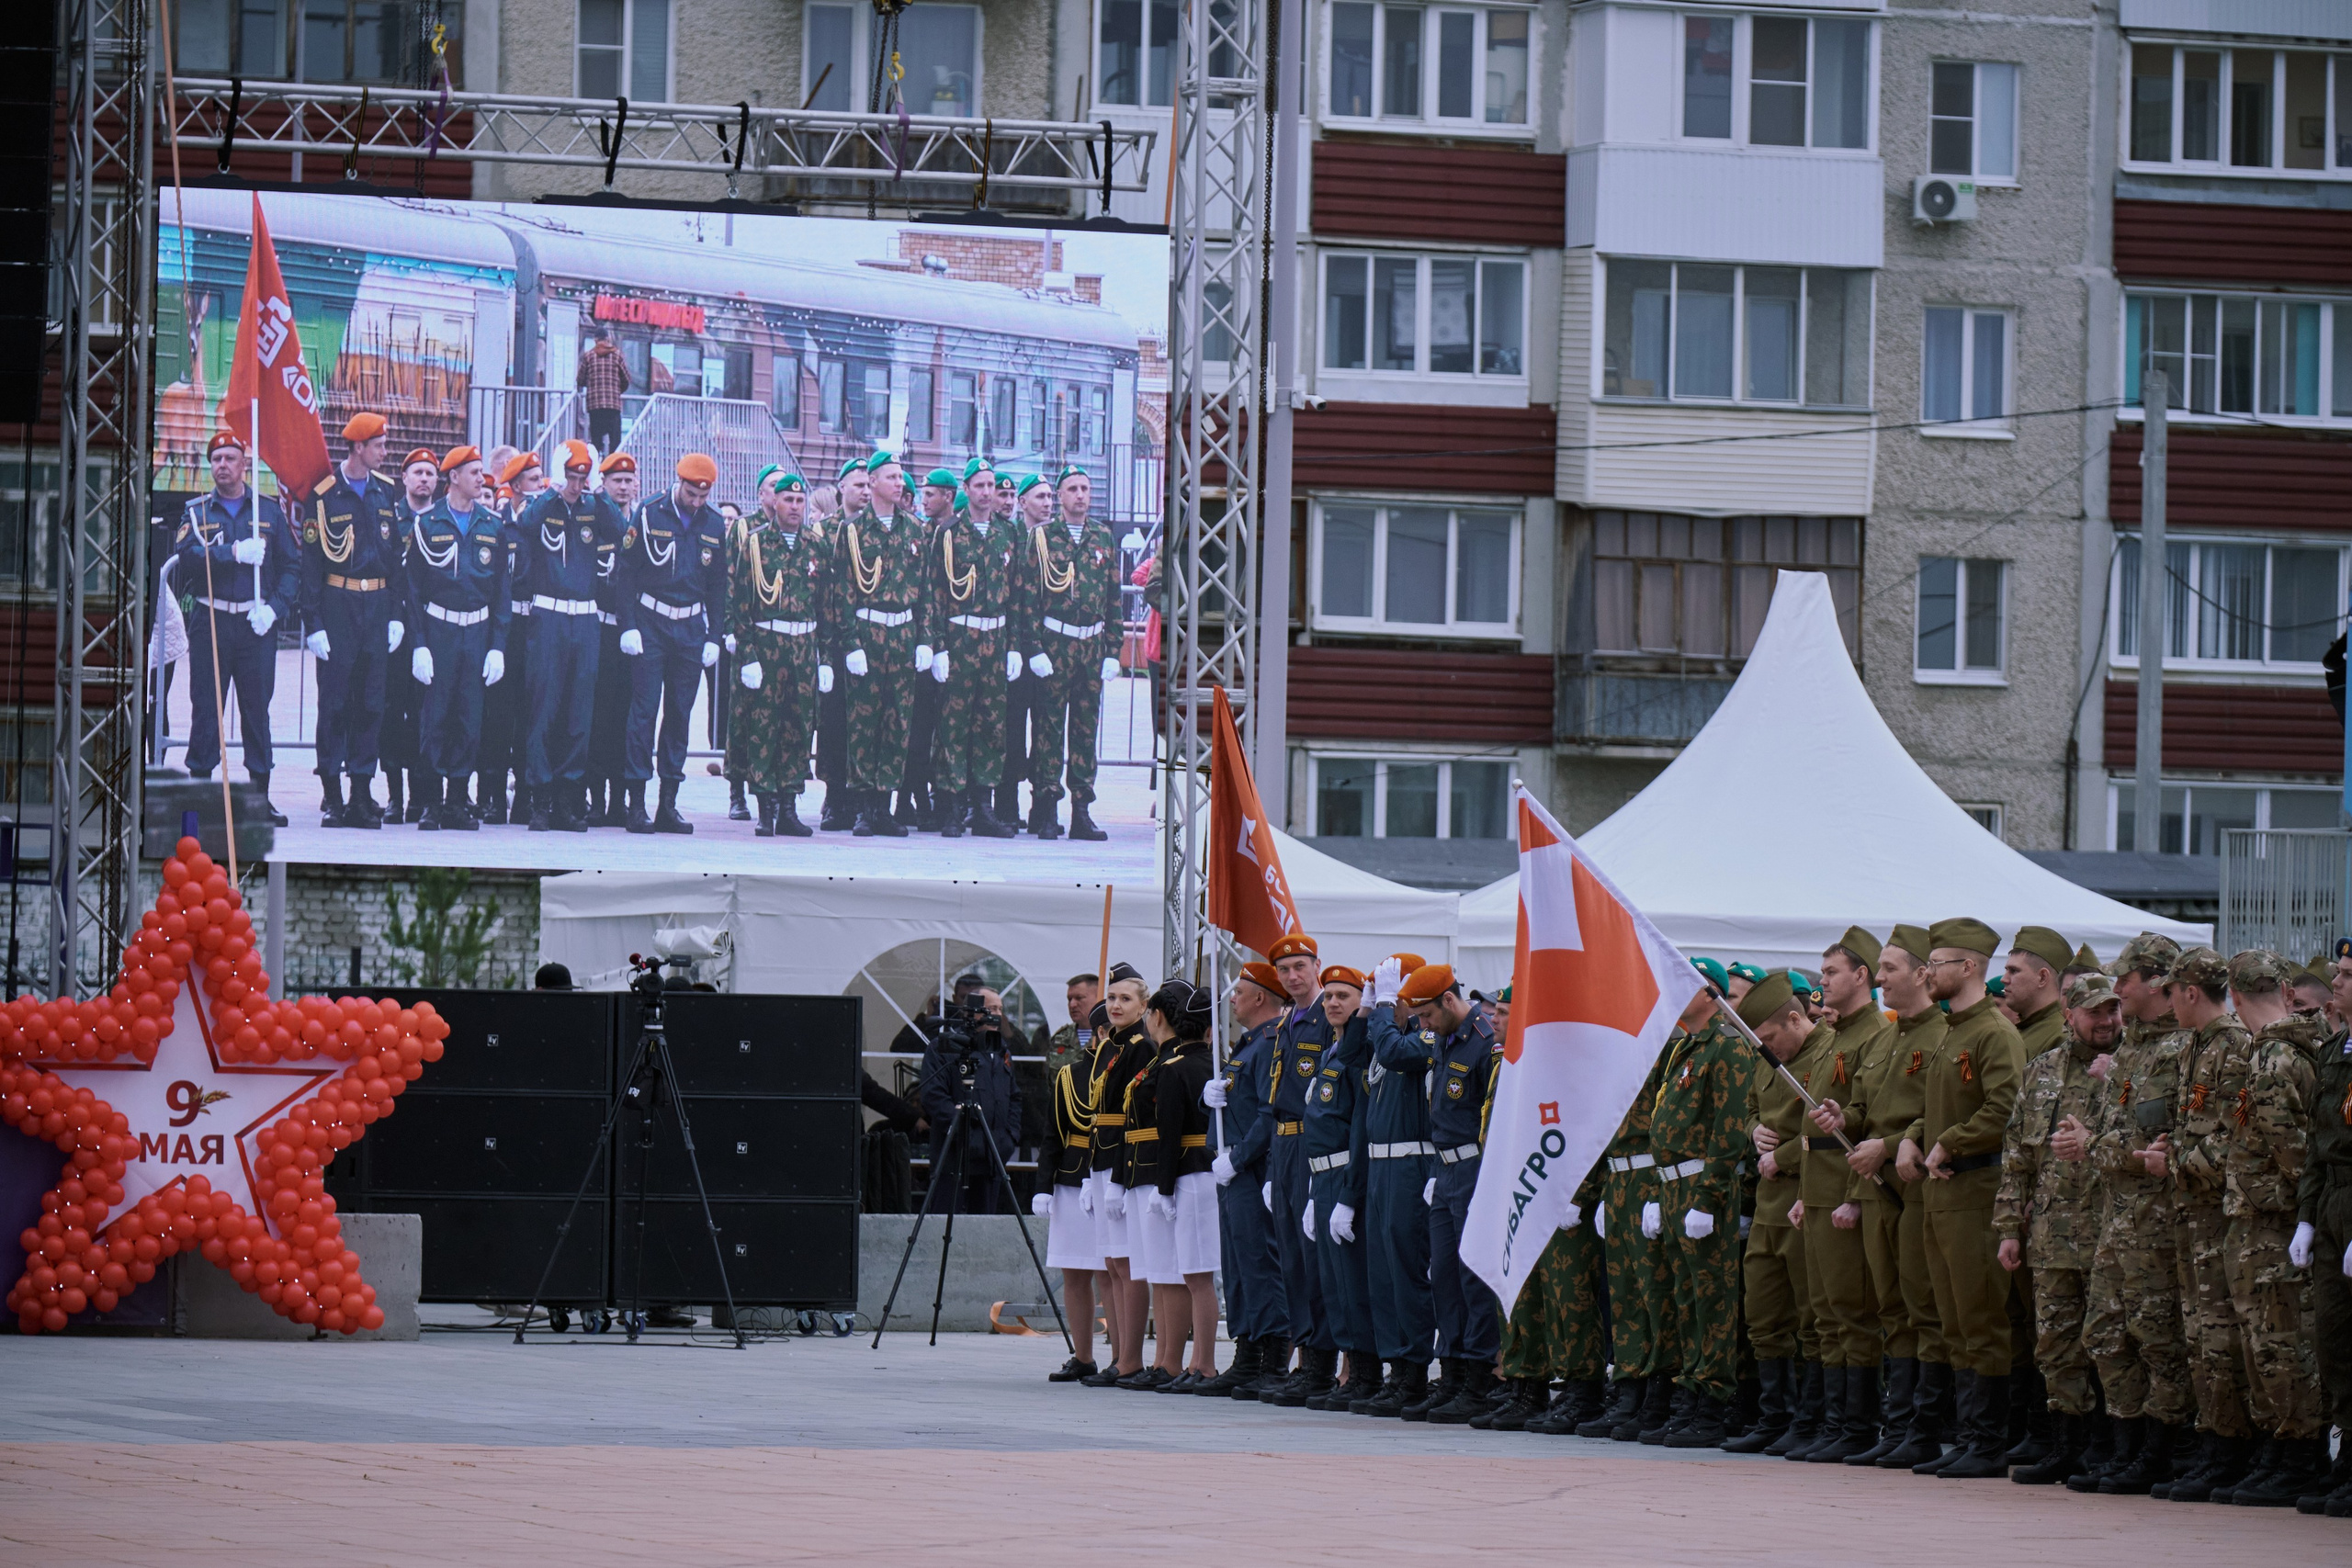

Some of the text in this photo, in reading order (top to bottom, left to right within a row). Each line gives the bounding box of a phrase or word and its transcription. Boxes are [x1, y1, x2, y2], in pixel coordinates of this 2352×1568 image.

[166, 1080, 201, 1127] 9
[139, 1133, 224, 1165] МАЯ
[1502, 1129, 1566, 1277] СИБАГРО
